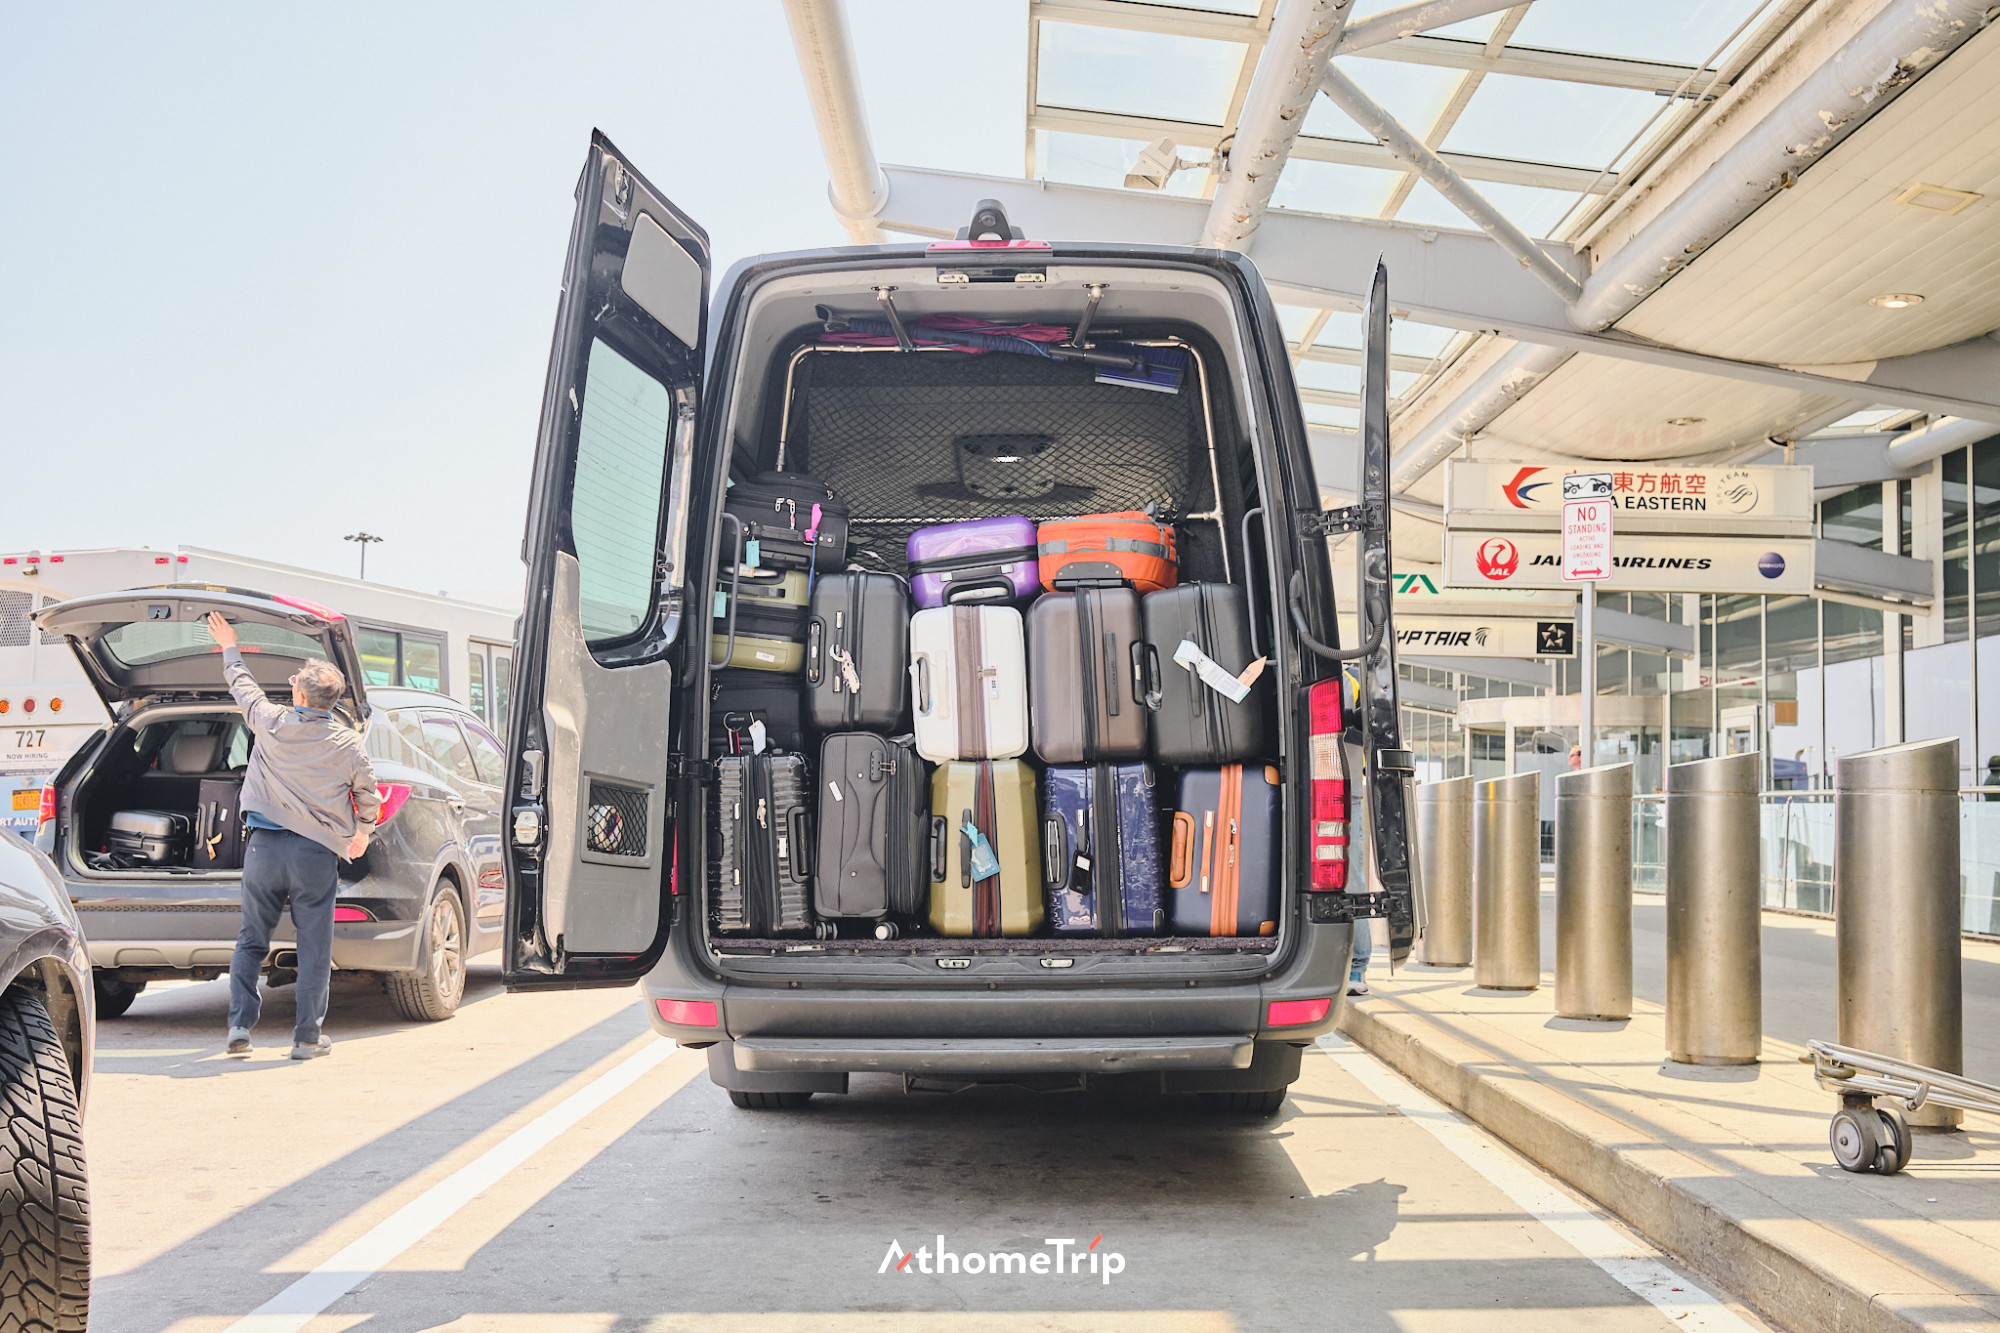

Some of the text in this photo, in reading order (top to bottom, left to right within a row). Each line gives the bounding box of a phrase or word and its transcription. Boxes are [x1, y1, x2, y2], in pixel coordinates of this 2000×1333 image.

[1613, 472, 1706, 495] 東方航空
[1625, 496, 1706, 511] EASTERN
[1577, 506, 1597, 521] NO
[1568, 522, 1607, 535] STANDING
[1613, 557, 1712, 570] AIRLINES
[1486, 567, 1511, 576] JAL
[1397, 630, 1472, 647] YPTAIR
[15, 729, 46, 748] 727
[14, 817, 39, 826] AUTH
